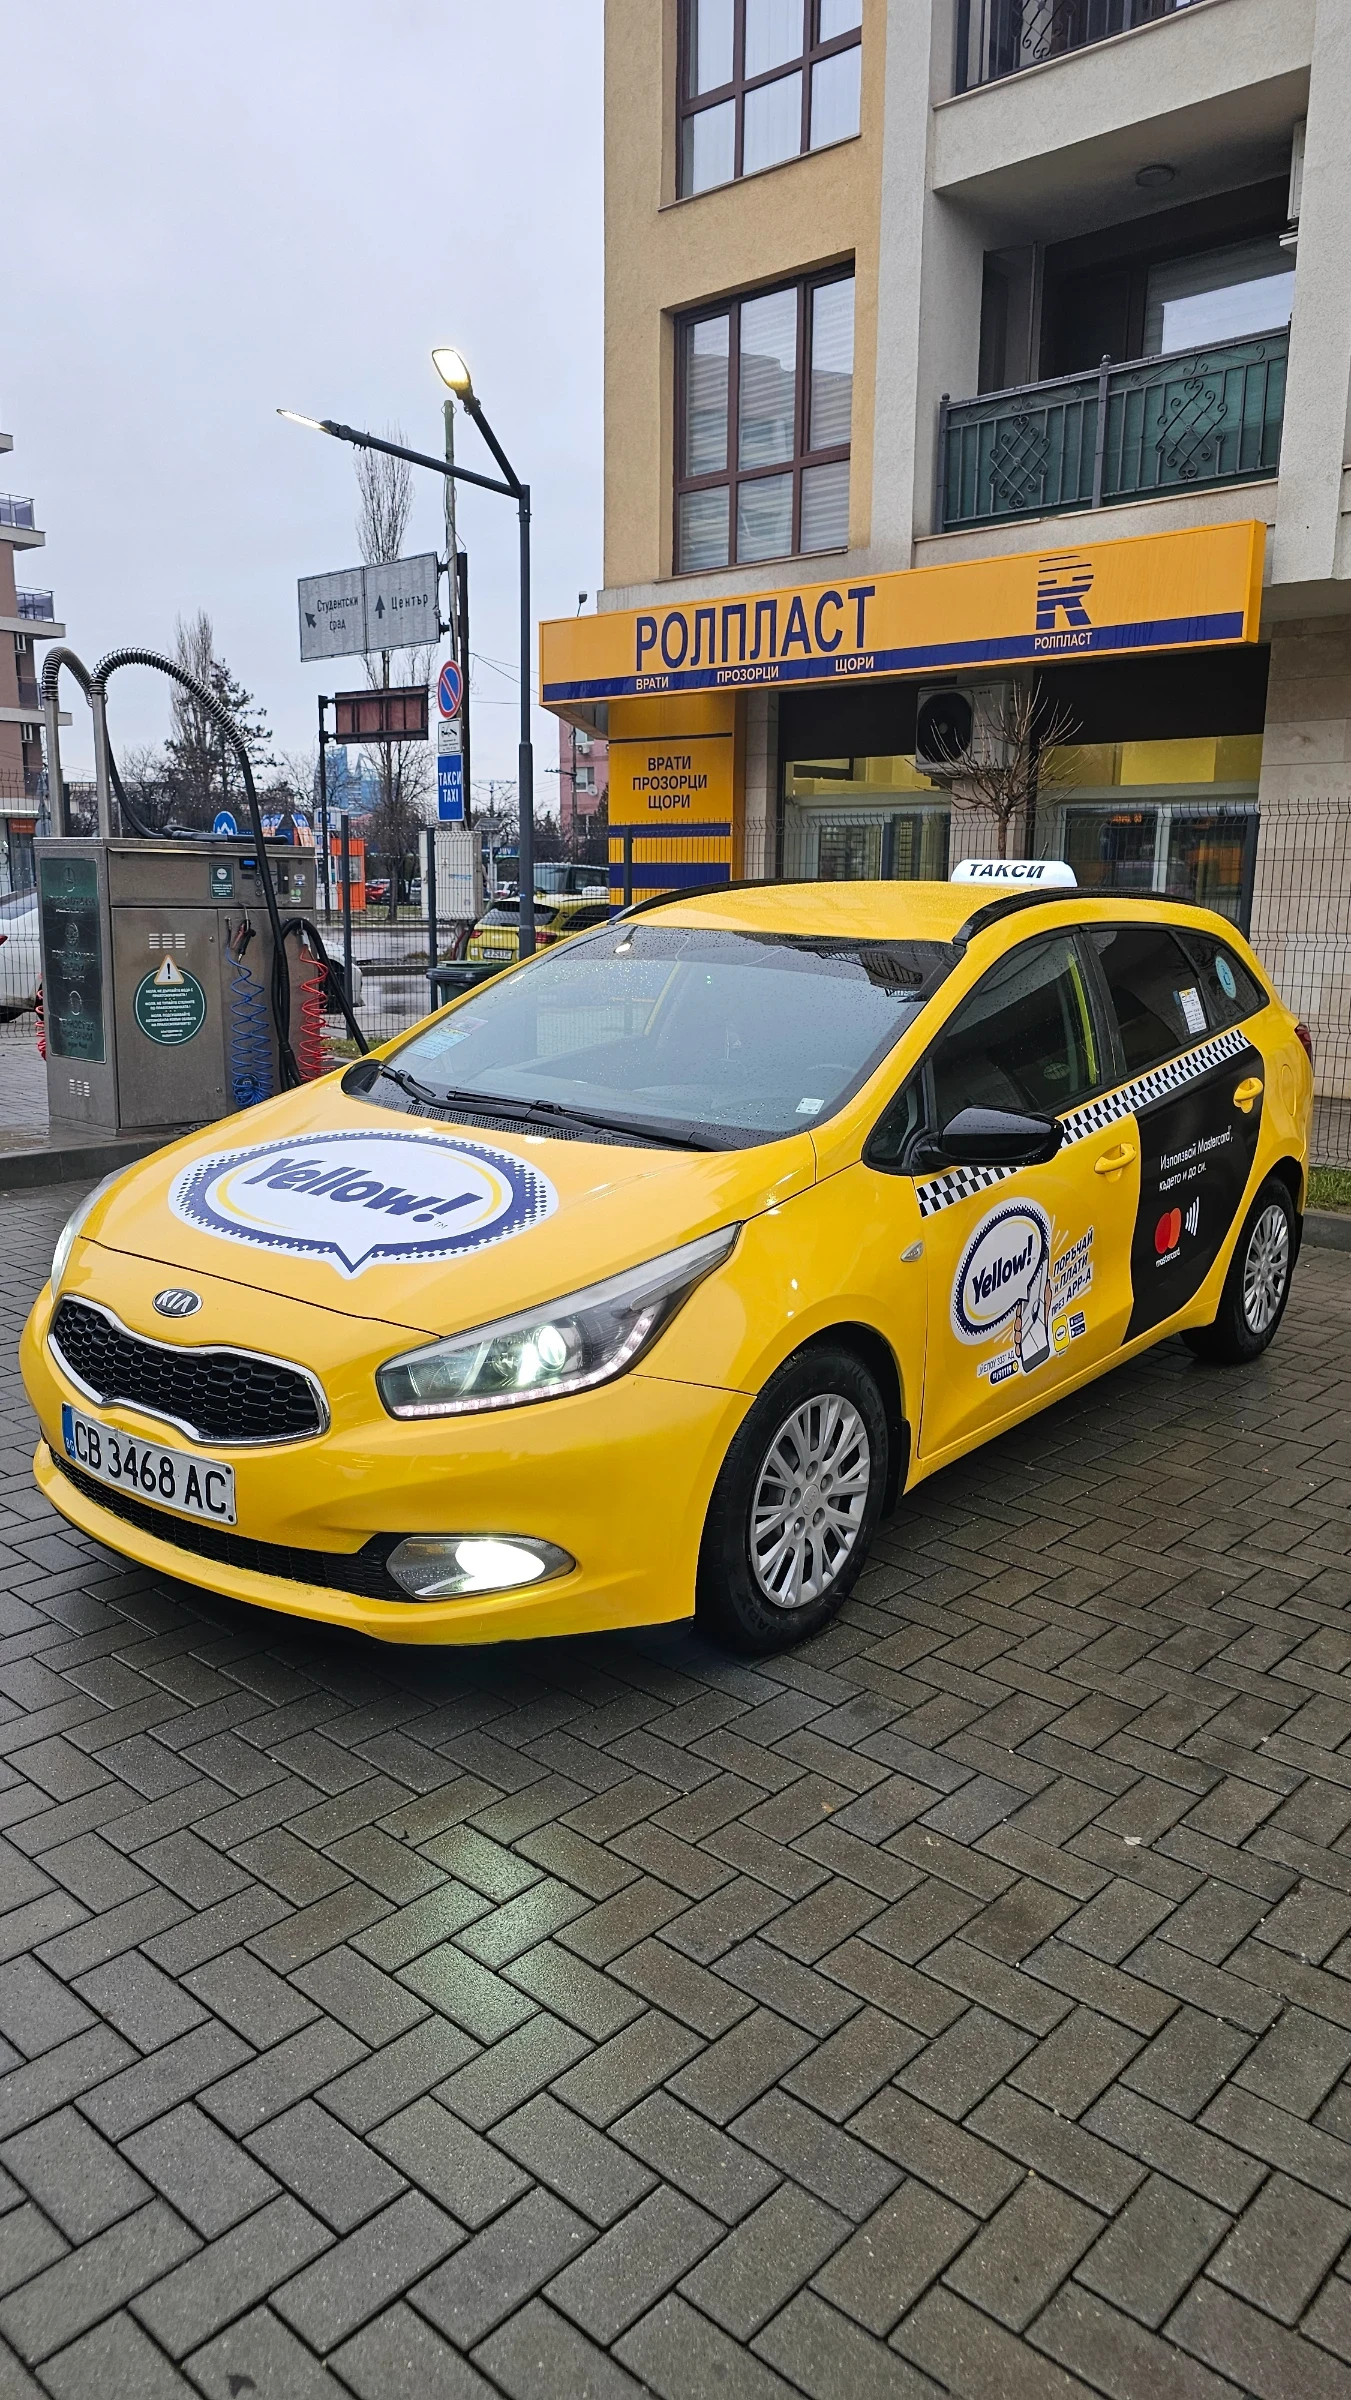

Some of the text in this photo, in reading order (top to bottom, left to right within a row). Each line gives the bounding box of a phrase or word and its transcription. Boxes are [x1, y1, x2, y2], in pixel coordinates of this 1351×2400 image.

[316, 595, 359, 613] Студентски
[391, 594, 429, 610] Център
[329, 619, 347, 633] град
[636, 585, 876, 672] РОЛПЛАСТ
[1034, 632, 1093, 650] РОЛПЛАСТ
[636, 656, 875, 691] ВРАТИ ПРОЗОРЦИ ЩОРИ
[648, 756, 692, 772] ВРАТИ
[439, 771, 462, 786] ТАКСИ
[632, 775, 708, 795] ПРОЗОРЦИ
[443, 788, 459, 803] TAXI
[648, 794, 691, 811] ЩОРИ
[969, 863, 1046, 879] ТАКСИ
[1159, 1161, 1207, 1192] където и до си.
[243, 1158, 483, 1223] Yellow!
[1053, 1226, 1094, 1278] ПОРЪЧАЙ
[1155, 1246, 1181, 1268] mastercard
[972, 1233, 1034, 1305] Yellow!
[1060, 1251, 1089, 1289] ПЛАТИ
[156, 1290, 193, 1313] KIA
[1052, 1297, 1065, 1317] ПРЕЗ
[65, 1437, 75, 1452] BG
[75, 1420, 227, 1514] CB 3468 AC
